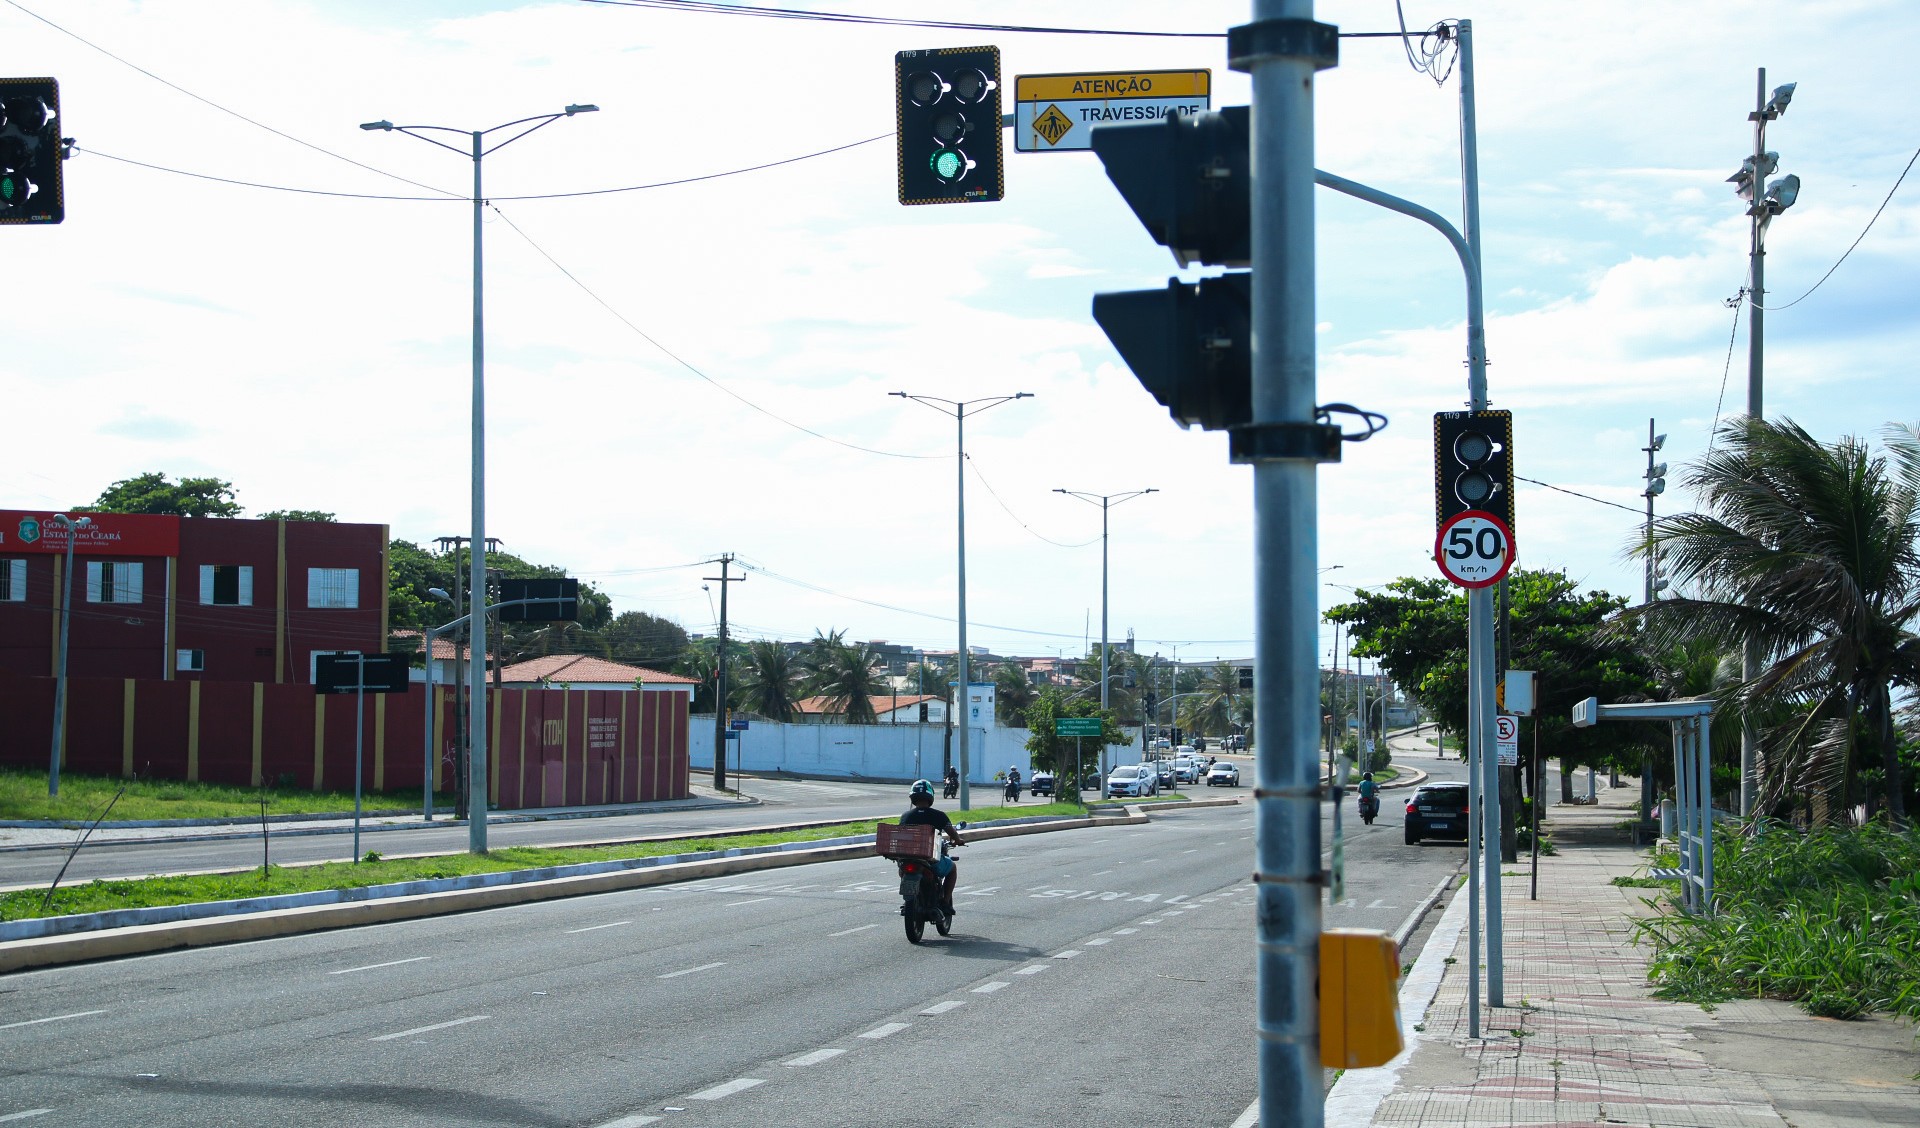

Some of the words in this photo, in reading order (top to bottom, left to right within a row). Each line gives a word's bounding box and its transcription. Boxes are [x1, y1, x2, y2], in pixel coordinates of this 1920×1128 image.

[1072, 76, 1152, 96] ATENÇÃO
[1080, 106, 1169, 122] TRAVESSIA
[1443, 412, 1460, 420] 1179
[90, 531, 121, 540] CEARÁ
[1448, 527, 1502, 560] 50
[1460, 565, 1487, 573] km/h
[543, 719, 563, 746] CTDH
[1499, 722, 1508, 735] E
[1028, 889, 1193, 905] SINAL
